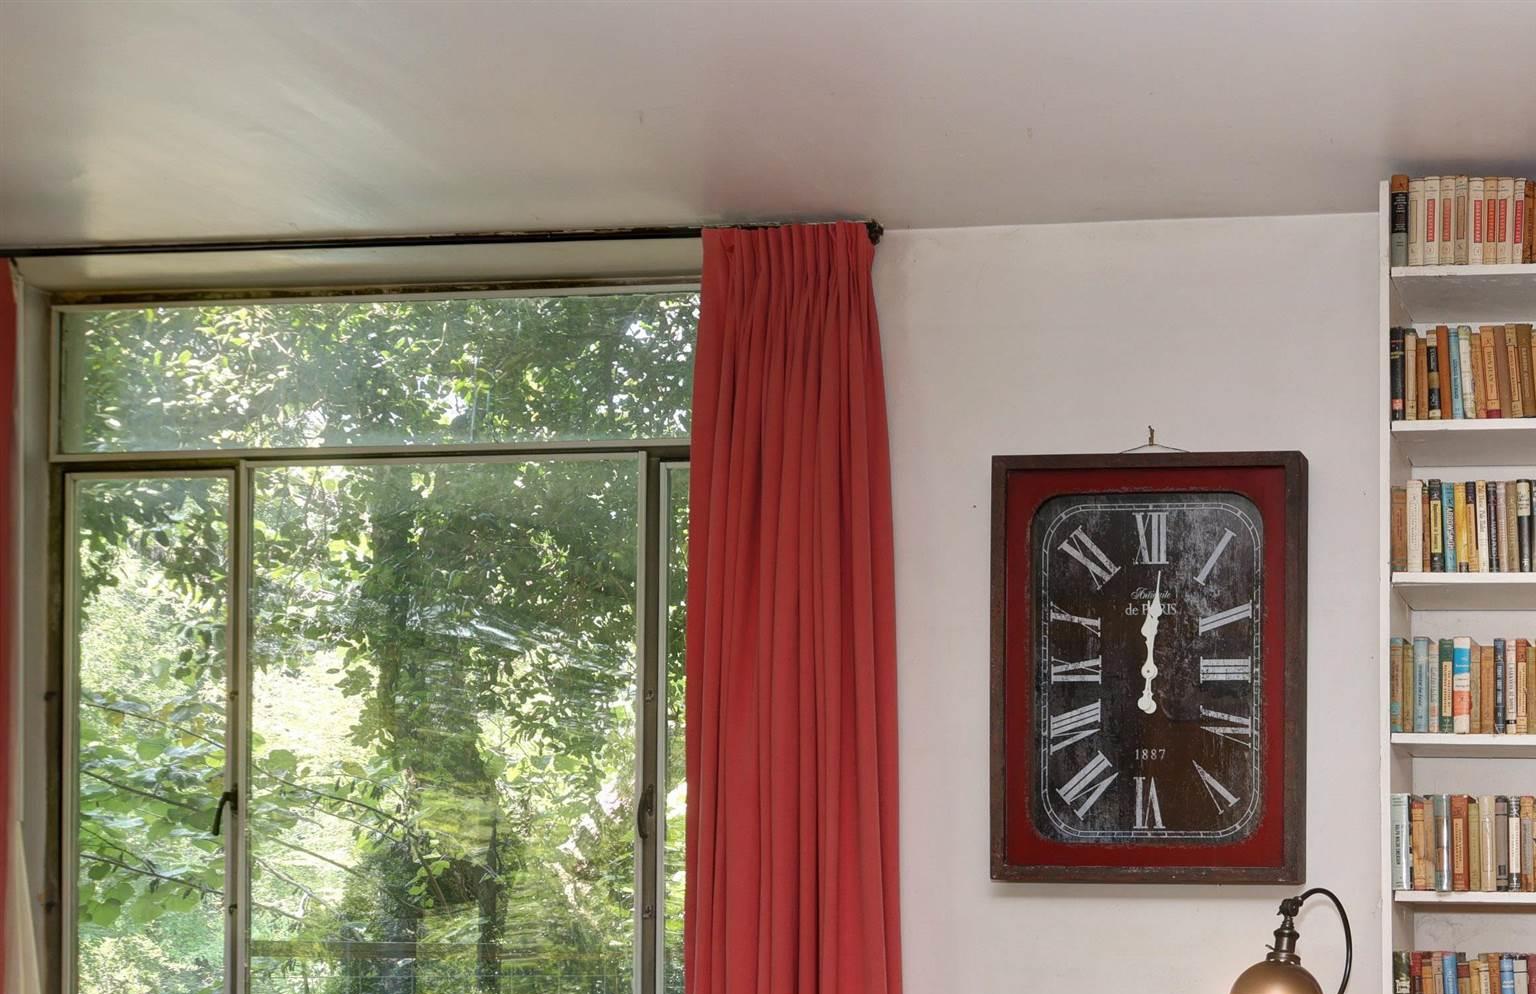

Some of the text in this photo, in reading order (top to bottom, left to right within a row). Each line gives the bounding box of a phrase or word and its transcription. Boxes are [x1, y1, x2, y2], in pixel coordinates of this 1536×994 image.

[1132, 512, 1169, 564] XII
[1447, 507, 1455, 549] ARROWSMITH
[1057, 525, 1122, 590] XI
[1193, 528, 1237, 585] I
[1050, 601, 1101, 637] X
[1125, 603, 1177, 615] de PRIS
[1199, 600, 1252, 636] II
[1051, 655, 1102, 684] IX
[1200, 656, 1251, 683] III
[1050, 699, 1101, 755] VIII
[1200, 705, 1251, 748] IV
[1135, 749, 1166, 760] 1887
[1056, 751, 1119, 820] VII
[1133, 777, 1166, 829] VI
[1192, 760, 1240, 815] V
